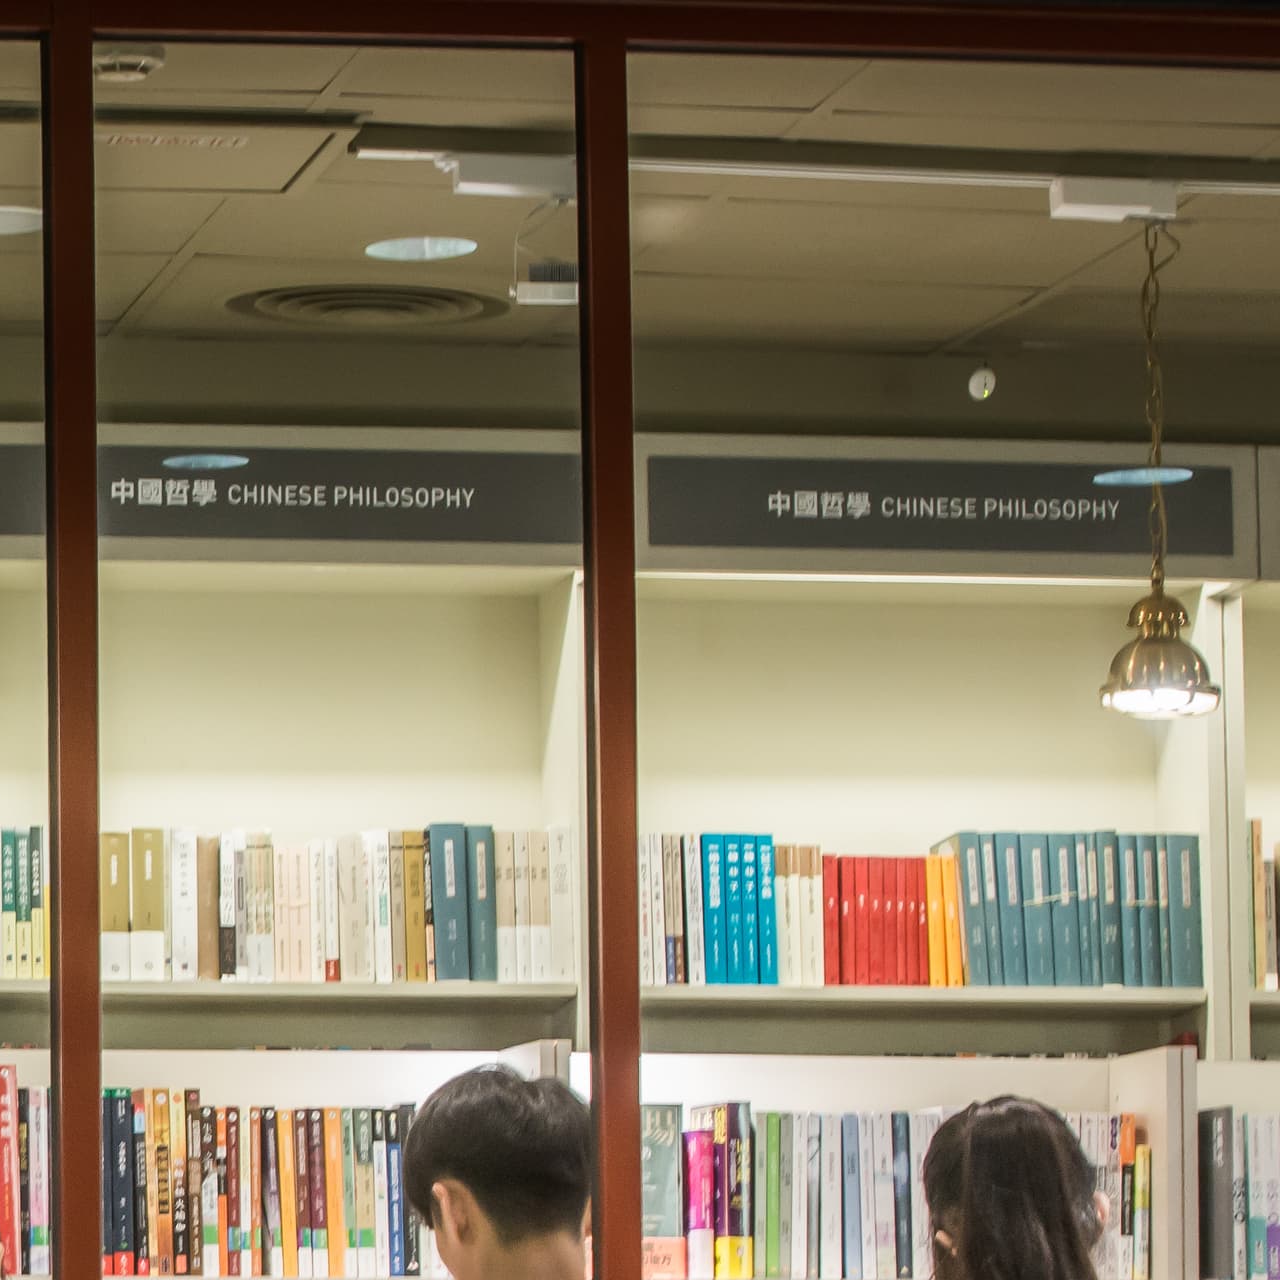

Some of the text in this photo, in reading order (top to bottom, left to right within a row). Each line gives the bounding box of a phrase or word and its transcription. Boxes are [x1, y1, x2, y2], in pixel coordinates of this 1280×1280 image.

[110, 477, 476, 509] 中國哲學 CHINESE PHILOSOPHY
[767, 490, 1120, 521] 中國哲學 CHINESE PHILOSOPHY
